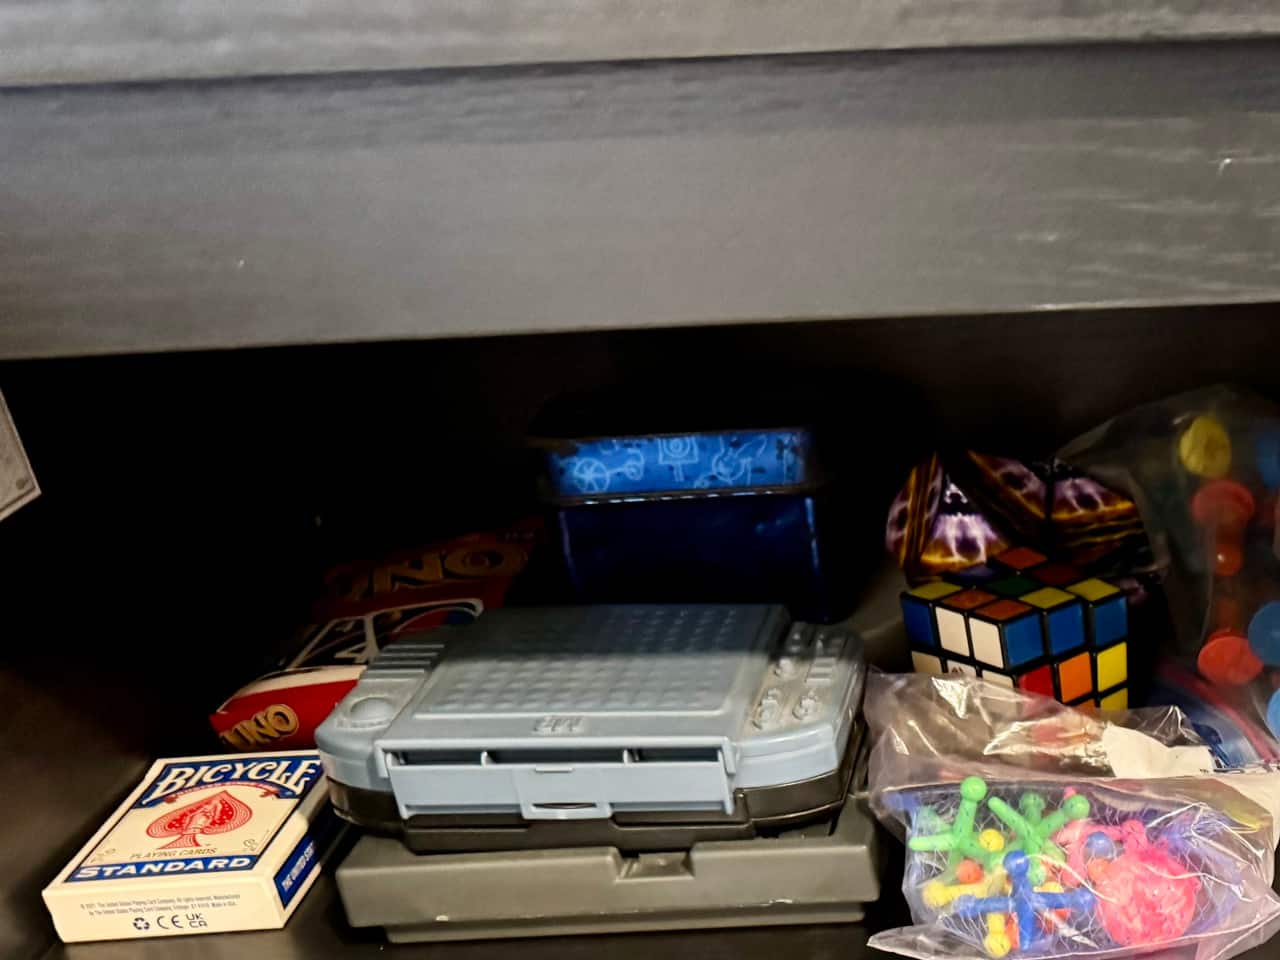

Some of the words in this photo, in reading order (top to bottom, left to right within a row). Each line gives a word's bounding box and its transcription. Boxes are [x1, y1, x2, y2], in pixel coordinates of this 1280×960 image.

[220, 703, 300, 750] UNO
[142, 760, 320, 805] BICYCLE
[76, 857, 250, 880] STANDARD
[130, 849, 177, 860] PLAYING
[180, 847, 217, 858] CARDS
